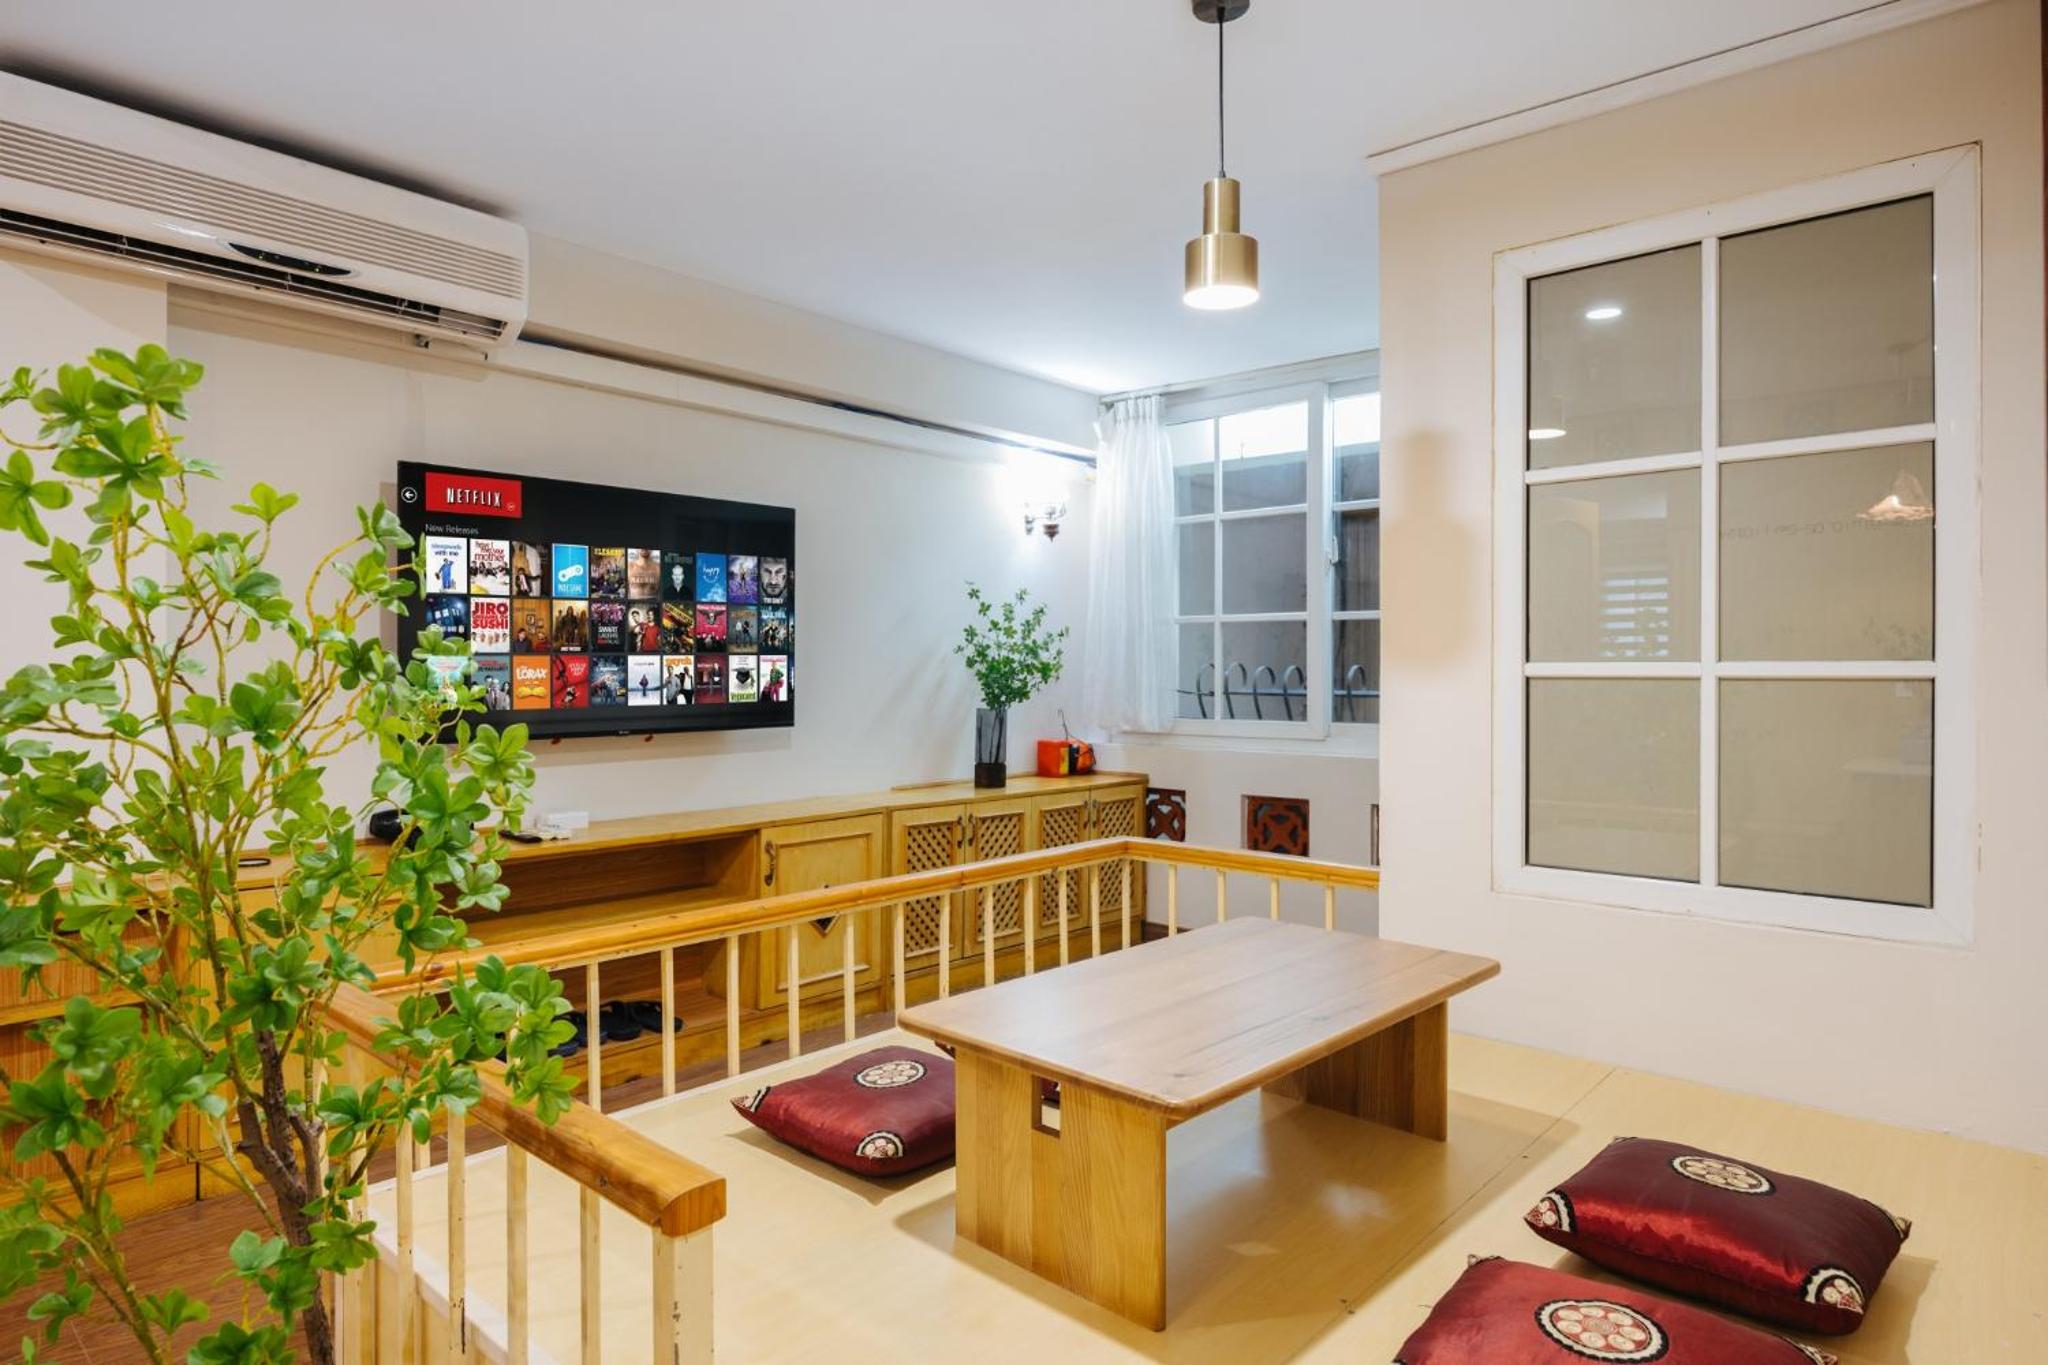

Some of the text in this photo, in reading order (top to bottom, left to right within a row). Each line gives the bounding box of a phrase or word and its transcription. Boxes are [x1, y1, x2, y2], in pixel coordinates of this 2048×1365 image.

[446, 488, 502, 508] NETFLIX
[425, 523, 479, 536] New Releases
[472, 602, 509, 615] JIRO
[472, 618, 509, 630] SUSHI
[516, 667, 548, 680] LORAX
